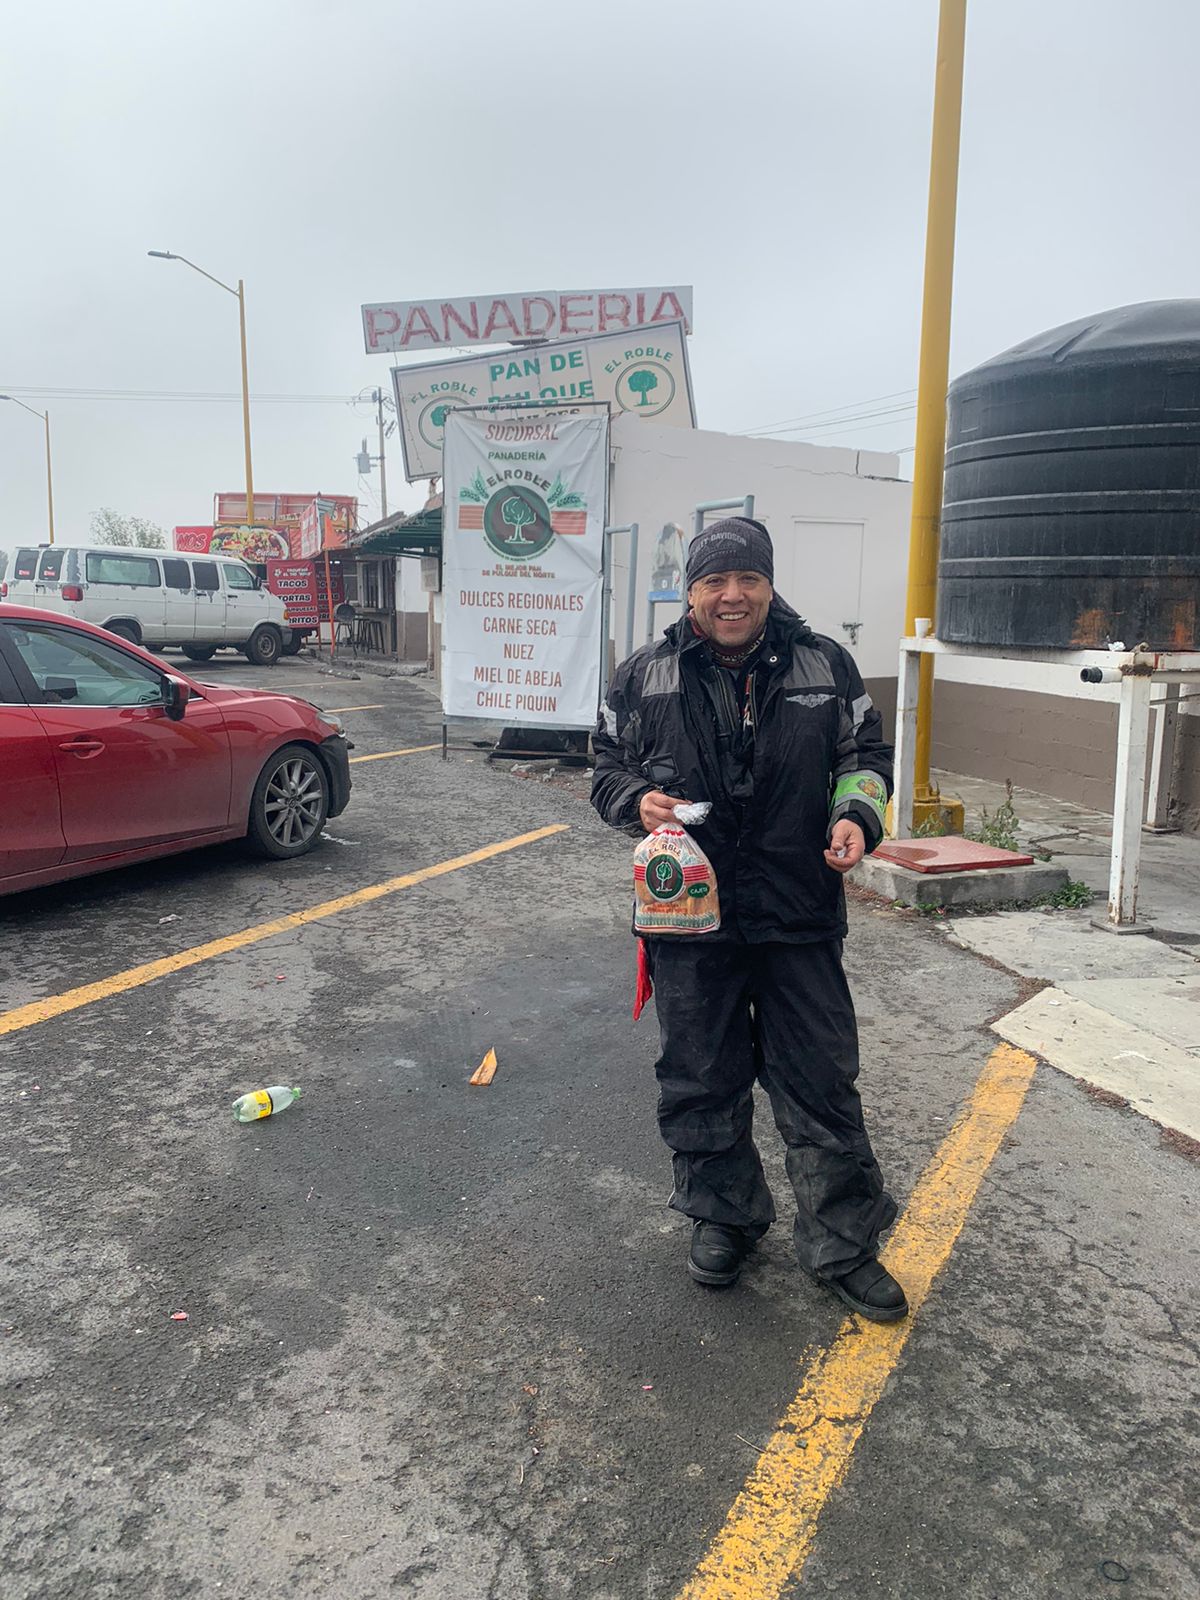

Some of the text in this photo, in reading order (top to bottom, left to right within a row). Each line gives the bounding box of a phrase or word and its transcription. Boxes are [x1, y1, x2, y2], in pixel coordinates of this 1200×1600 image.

[365, 291, 692, 347] PANADERIA
[490, 350, 584, 382] PAN DE
[604, 346, 674, 374] EL ROBLE
[410, 381, 479, 404] EL ROBLE
[485, 424, 559, 441] SUCURSAL
[488, 450, 546, 461] PANADERÍA
[277, 580, 308, 588] TACOS
[277, 594, 311, 602] TORTAS
[460, 590, 584, 611] DULCES REGIONALES
[483, 617, 557, 636] CARNE SECA
[504, 643, 534, 660] NUEZ
[474, 666, 562, 687] MIEL DE ABEJA
[477, 691, 557, 712] CHILE PIQUIN
